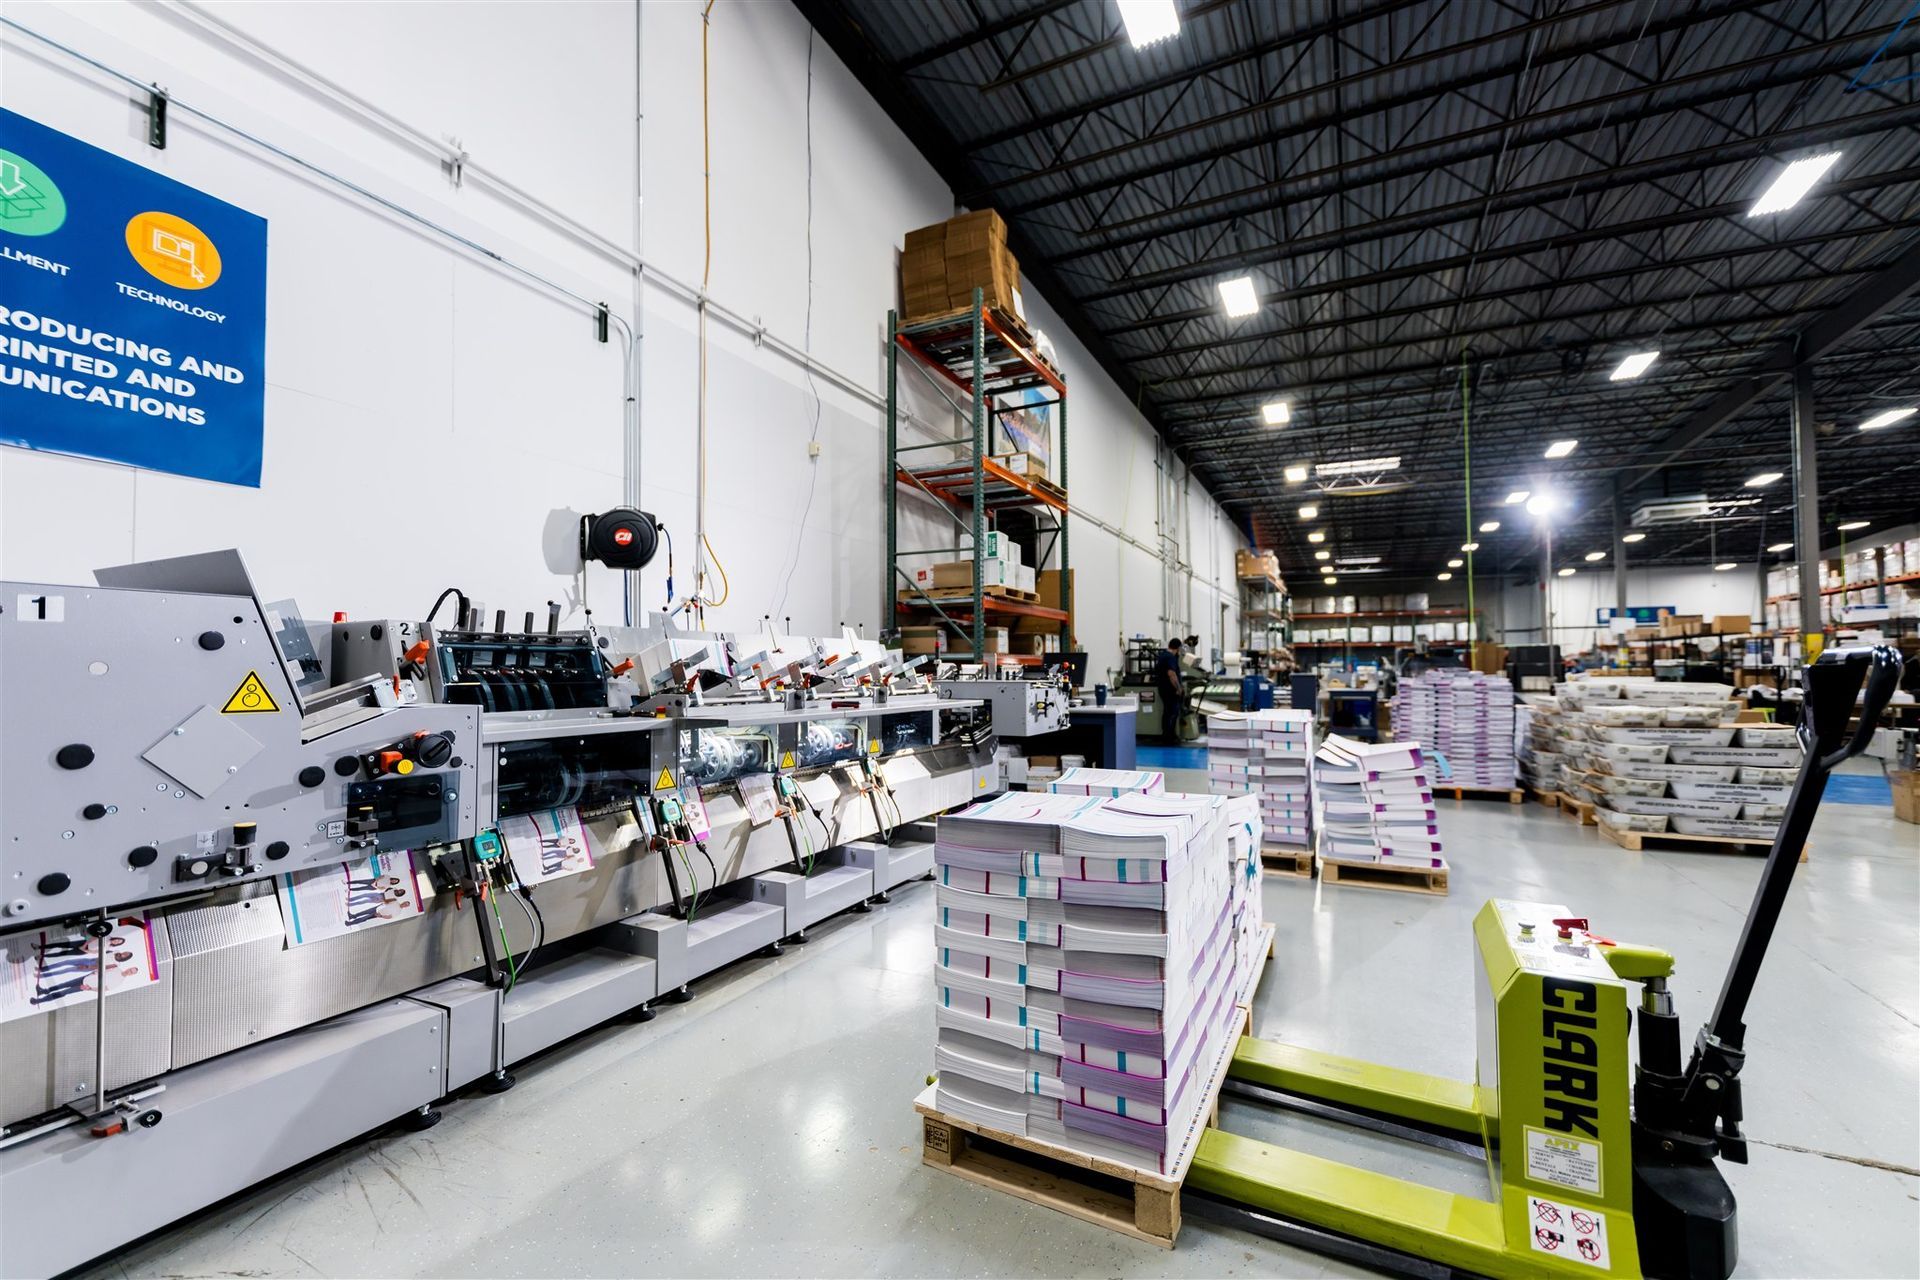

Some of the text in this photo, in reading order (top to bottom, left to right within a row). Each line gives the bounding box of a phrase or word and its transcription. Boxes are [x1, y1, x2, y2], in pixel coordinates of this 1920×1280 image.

[0, 246, 71, 276] LMENT
[116, 282, 226, 324] TECHNOLOGY
[126, 368, 196, 397] AND
[179, 356, 244, 384] AND
[32, 597, 46, 620] 1
[400, 622, 410, 636] 2
[590, 626, 597, 636] 3
[1542, 976, 1599, 1140] CLARK
